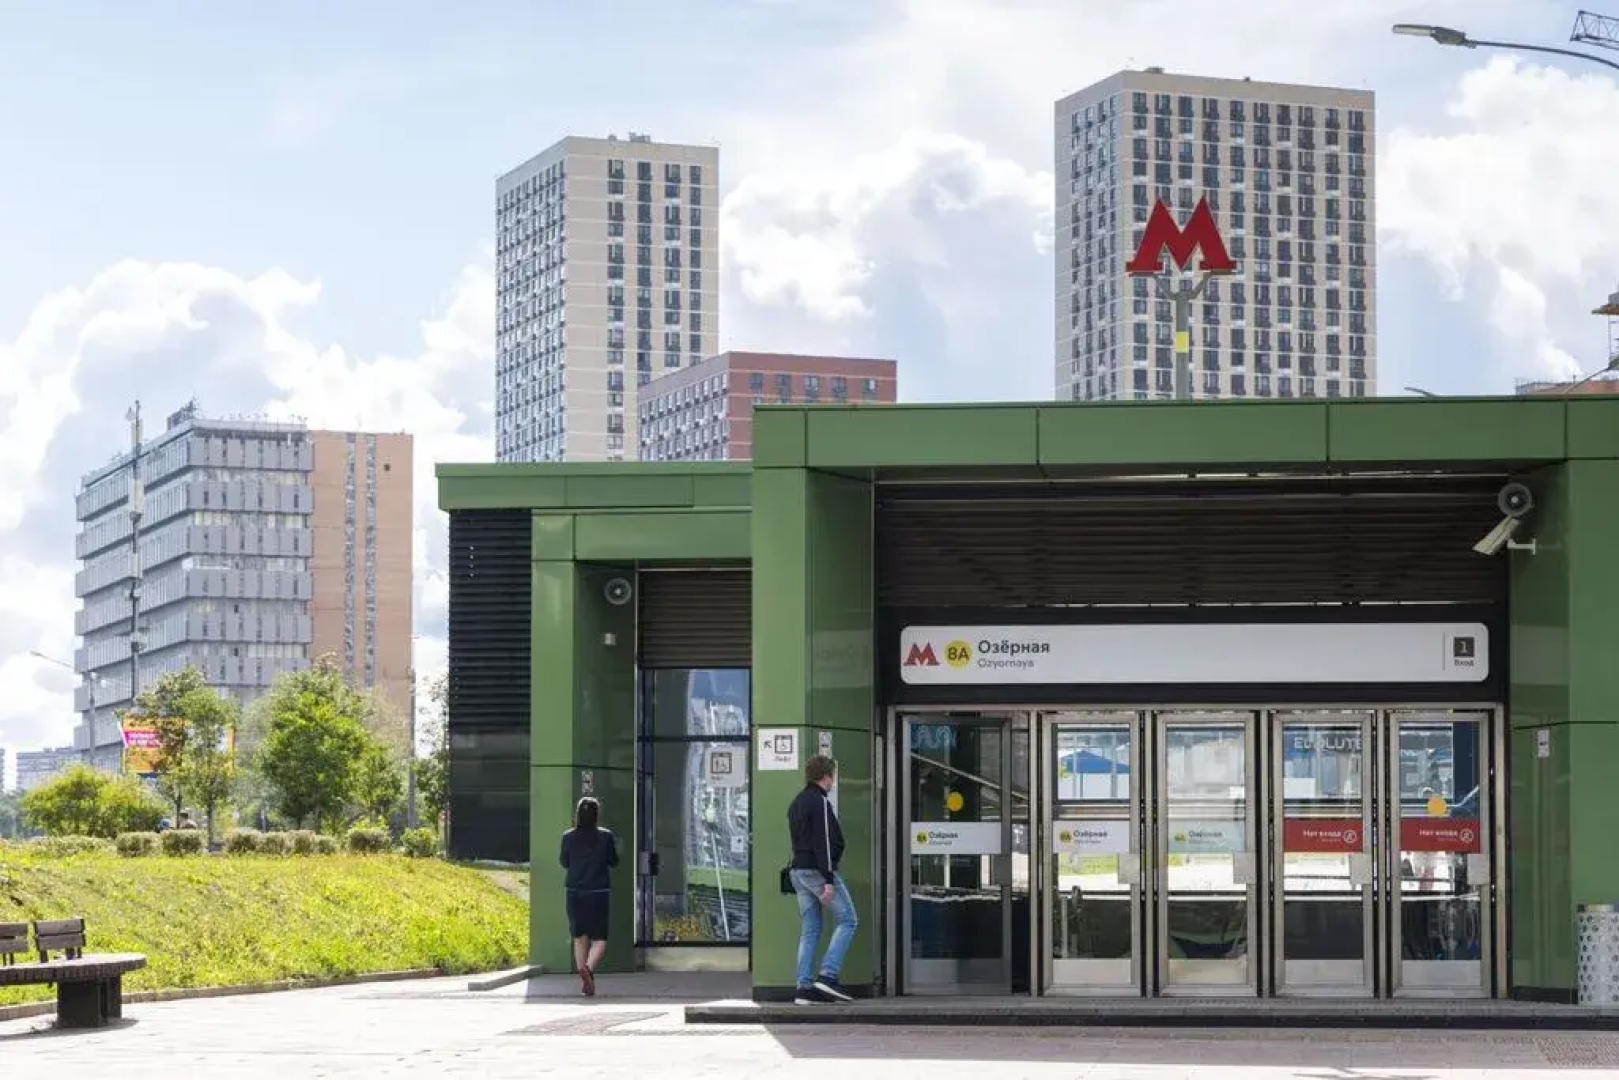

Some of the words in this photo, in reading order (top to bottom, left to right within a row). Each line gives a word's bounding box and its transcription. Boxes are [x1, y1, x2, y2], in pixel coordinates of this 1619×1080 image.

[1125, 195, 1237, 272] М
[978, 640, 1050, 655] Озёрная
[978, 658, 1034, 669] Ozyornaya
